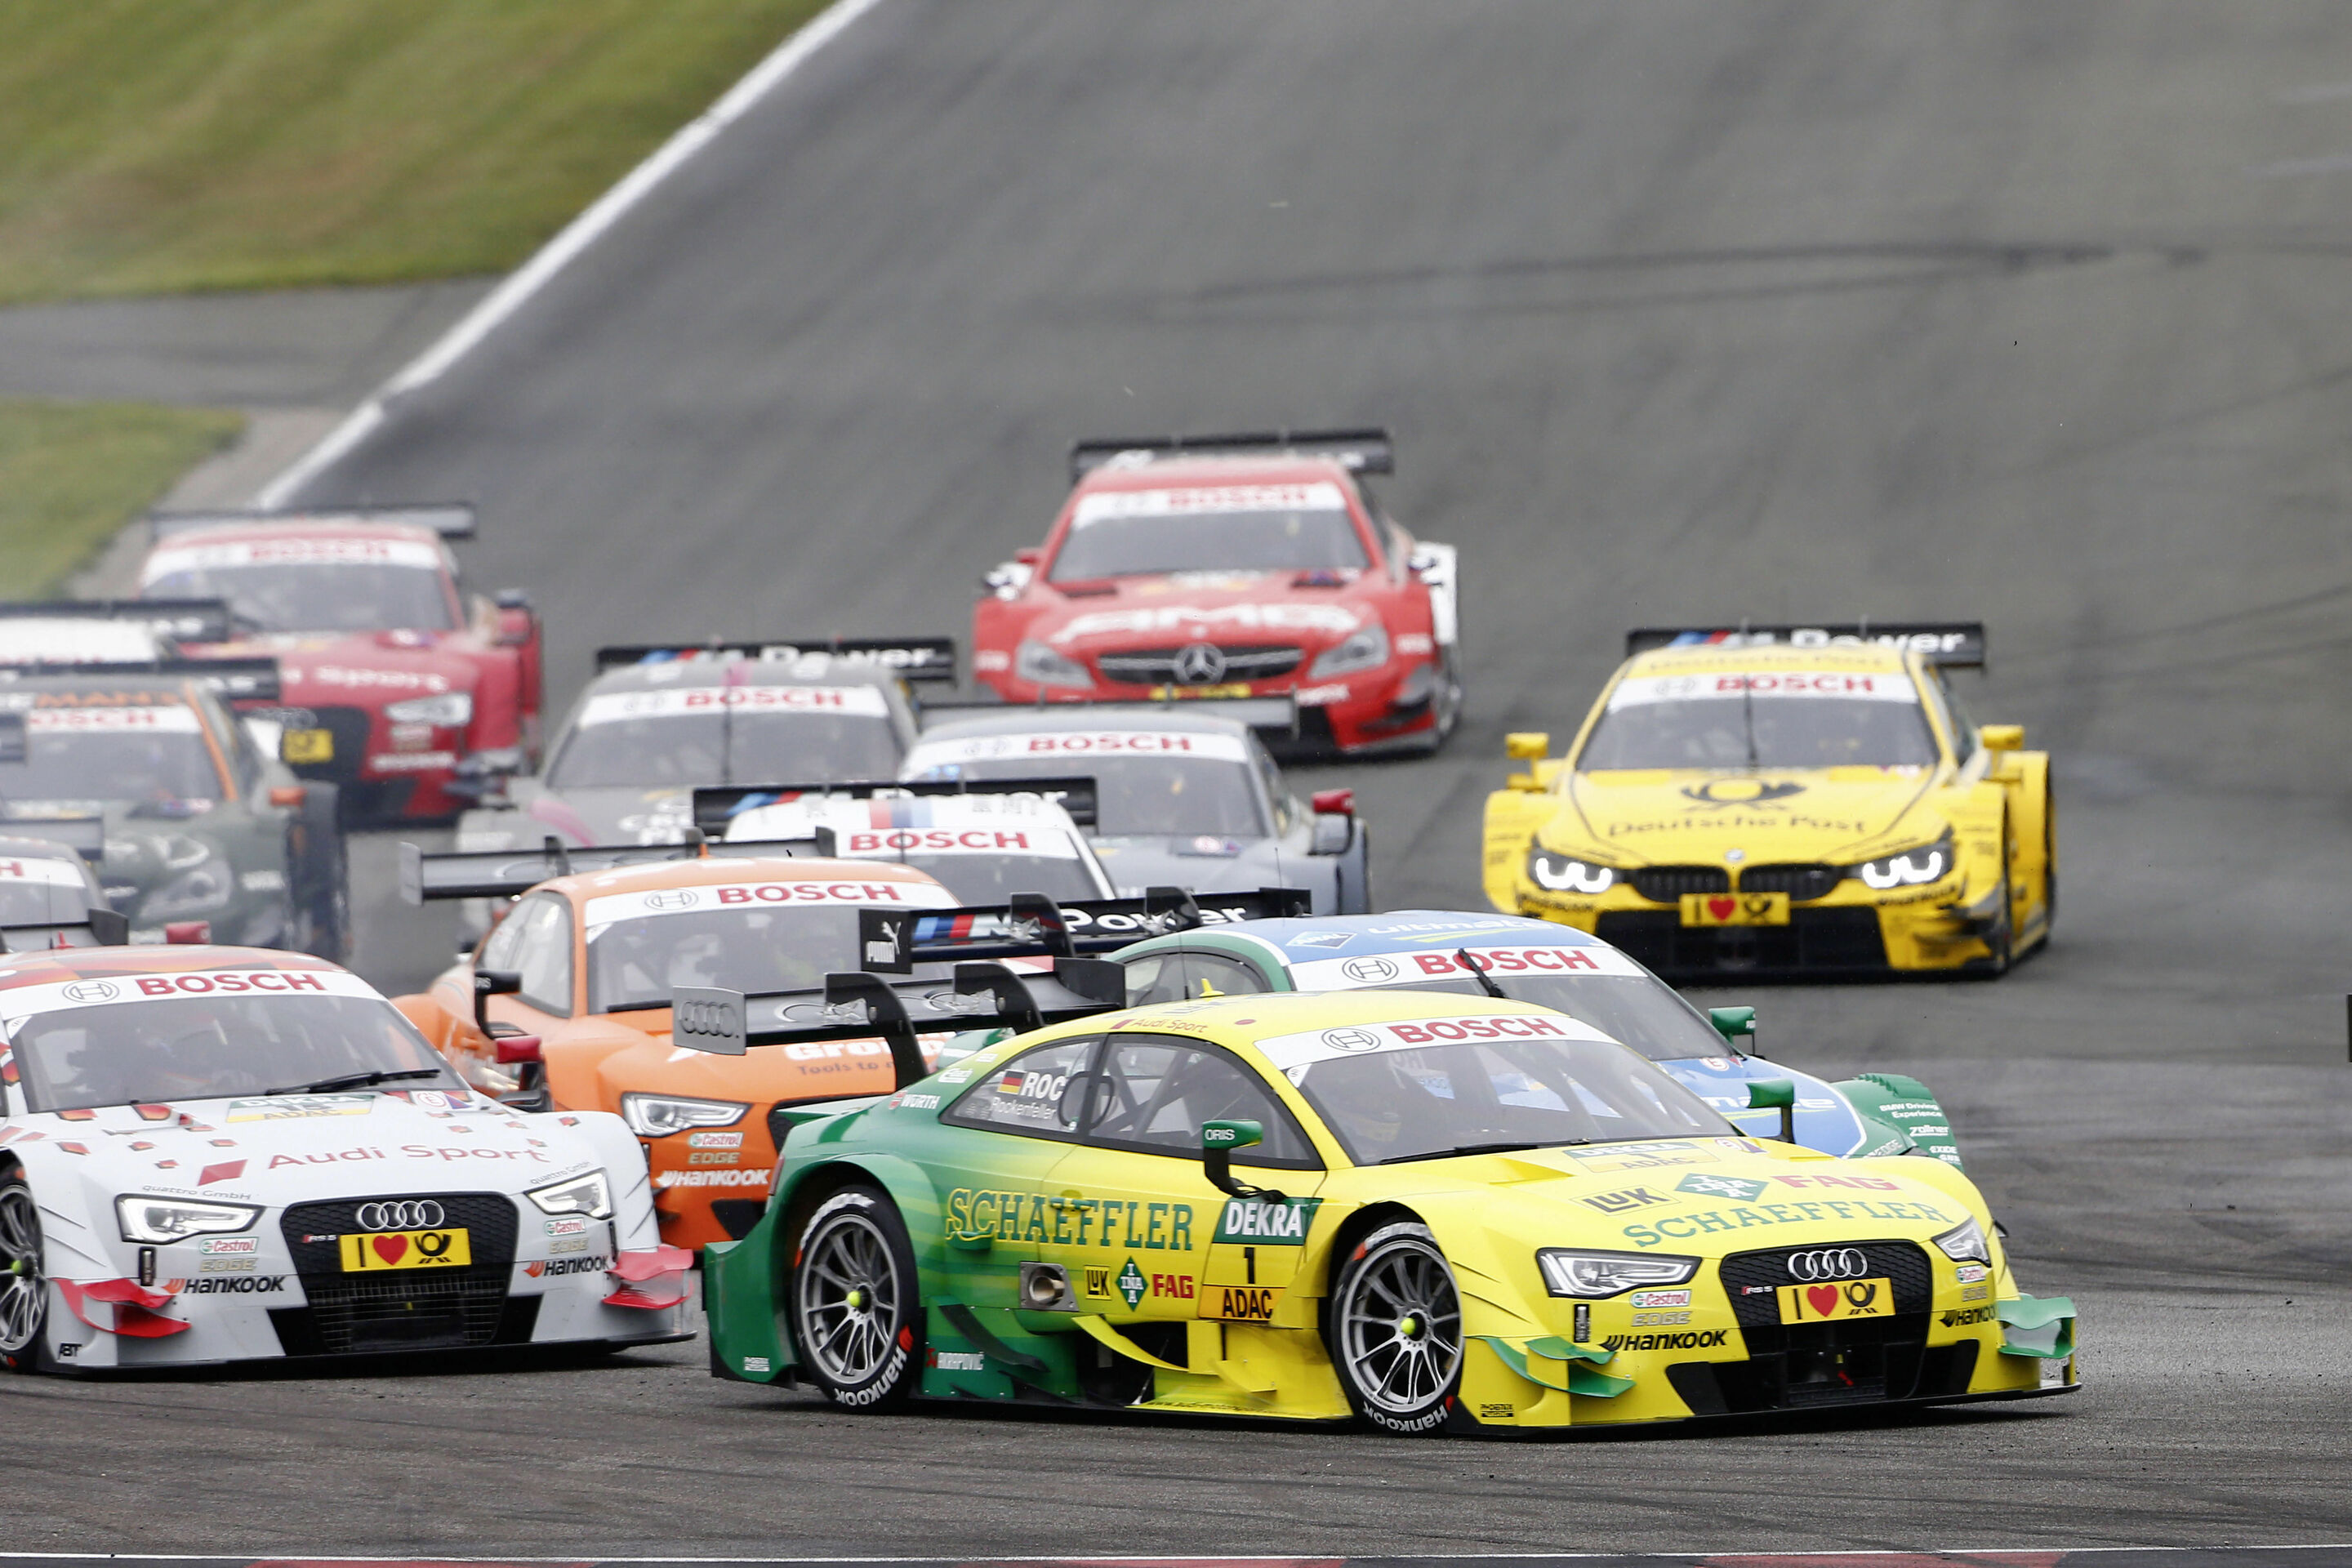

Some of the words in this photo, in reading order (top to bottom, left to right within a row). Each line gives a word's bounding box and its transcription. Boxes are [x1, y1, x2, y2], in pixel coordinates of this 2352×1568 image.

[1717, 675, 1874, 692] BOSCH
[686, 690, 844, 706] BOSCH
[29, 710, 155, 726] OSCH
[1028, 735, 1192, 752] BOSCH
[1609, 817, 1778, 838] Deutsche
[1790, 815, 1866, 832] Post
[849, 831, 1029, 851] BOSCH
[717, 884, 902, 904] BOSCH
[1412, 950, 1599, 975] BOSCH
[135, 973, 327, 996] BOSCH
[1387, 1018, 1567, 1044] BOSCH
[1019, 1071, 1069, 1101] ROC
[1205, 1129, 1236, 1141] ORIS
[268, 1147, 385, 1169] Audi
[401, 1144, 551, 1163] Sport
[688, 1152, 741, 1165] EDGE
[1570, 1143, 1695, 1156] DEKRA
[1619, 1157, 1696, 1169] ADAC
[142, 1185, 198, 1196] quattro
[202, 1190, 252, 1200] GmbH
[1772, 1175, 1901, 1191] FAG
[946, 1187, 1195, 1252] SCHAEFFLER
[1225, 1201, 1303, 1237] DEKRA
[1622, 1200, 1956, 1247] SCHAEFFLER
[214, 1239, 255, 1253] Castrol
[357, 1236, 367, 1267] I
[550, 1238, 590, 1254] EDGE
[199, 1258, 259, 1272] EDGE
[1244, 1246, 1256, 1285] 1
[183, 1276, 286, 1294] Hankook
[1152, 1273, 1195, 1299] FAG
[1223, 1288, 1273, 1320] ADAC
[1646, 1291, 1688, 1306] Castrol
[1793, 1288, 1803, 1320] I
[1632, 1312, 1692, 1326] EDGE
[1624, 1330, 1728, 1351] Hankook
